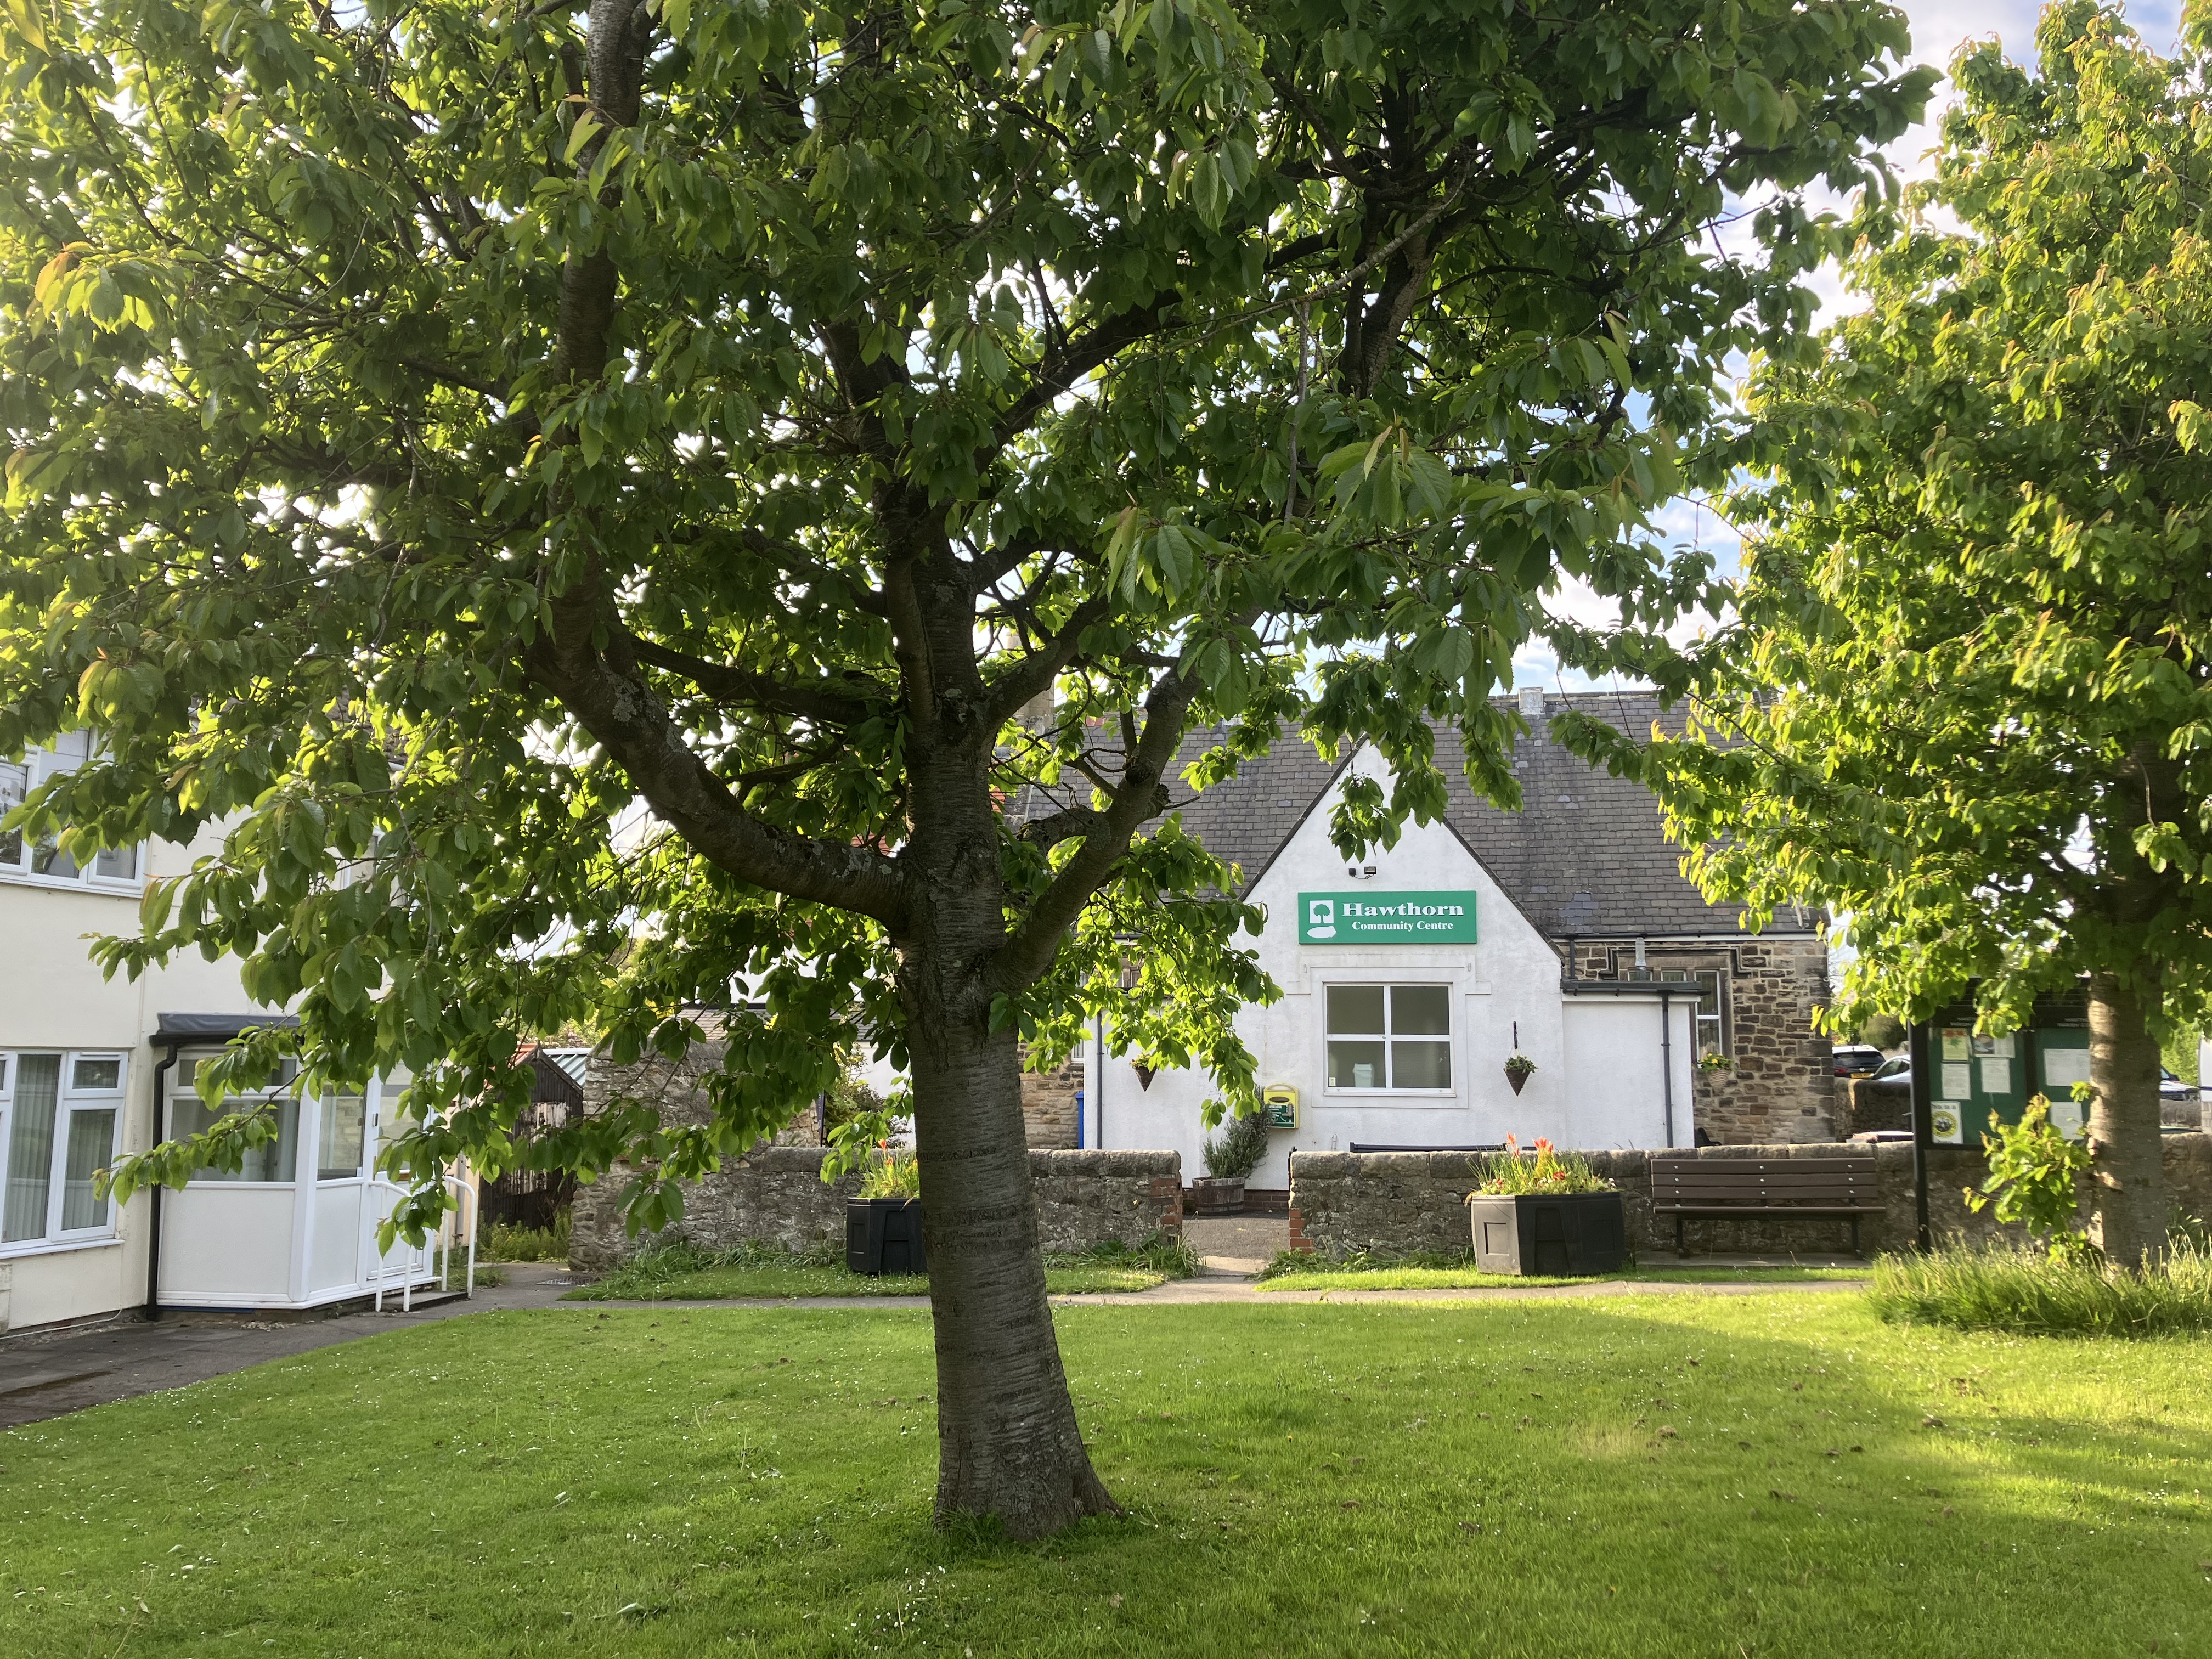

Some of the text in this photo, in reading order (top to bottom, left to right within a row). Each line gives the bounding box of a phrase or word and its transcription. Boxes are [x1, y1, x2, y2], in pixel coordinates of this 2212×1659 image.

[1342, 902, 1464, 917] Hawthorn
[1352, 921, 1454, 932] Community Centre
